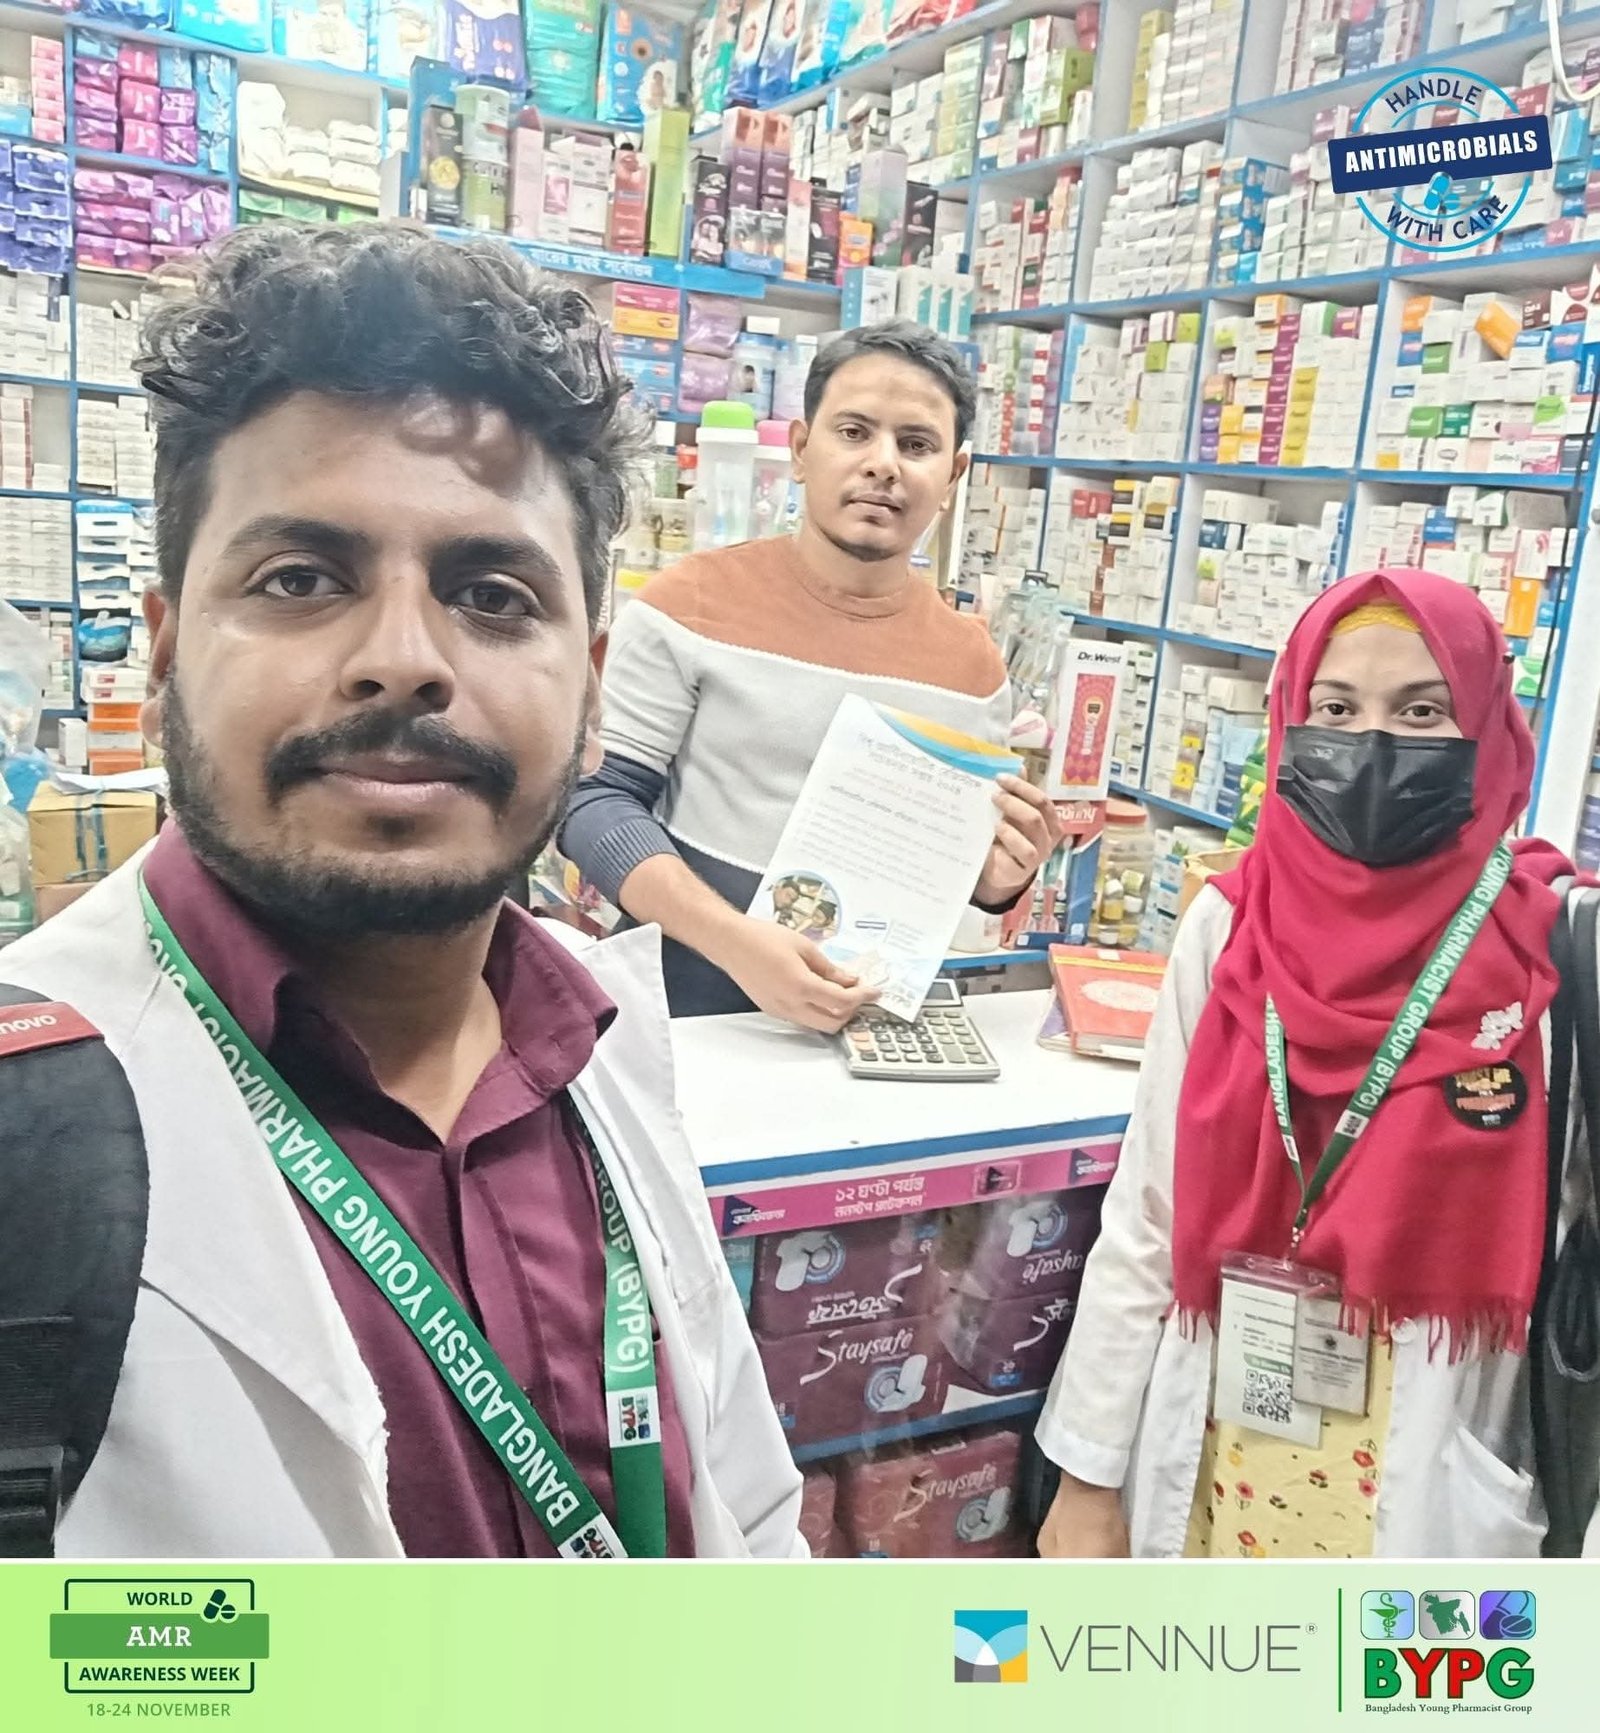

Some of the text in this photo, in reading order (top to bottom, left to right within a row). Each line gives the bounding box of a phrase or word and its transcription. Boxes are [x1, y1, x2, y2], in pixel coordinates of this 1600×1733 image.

[1473, 849, 1514, 903] YOUNG
[1416, 900, 1488, 1006] PHARMACIST
[0, 1014, 57, 1035] novo
[1390, 1001, 1430, 1062] GROUP
[1264, 1009, 1289, 1128] BANGLADESH
[1353, 1056, 1396, 1112] (BYPG)
[835, 1186, 855, 1203] ১২
[194, 1002, 581, 1528] BANGLADESH YOUNG PHARMACIS
[609, 1261, 650, 1373] (BYPG)
[800, 1328, 915, 1386] Staysafe
[893, 1462, 998, 1523] Staysafe
